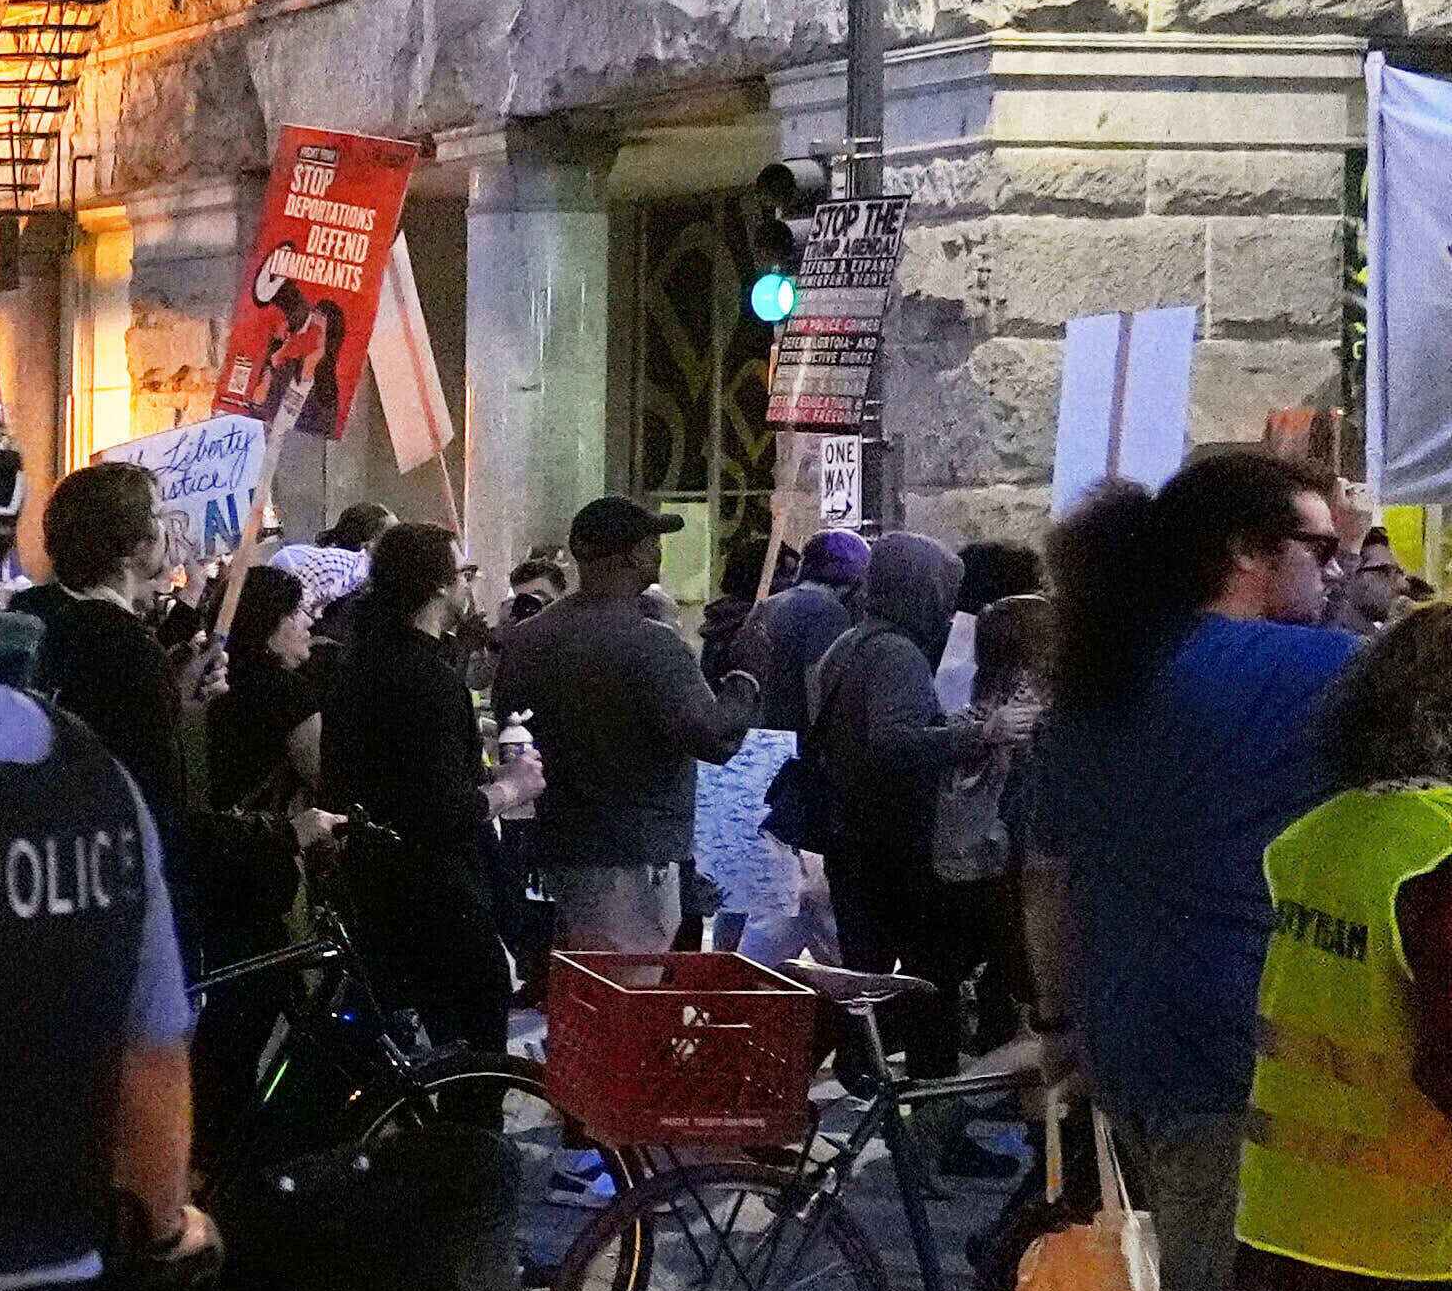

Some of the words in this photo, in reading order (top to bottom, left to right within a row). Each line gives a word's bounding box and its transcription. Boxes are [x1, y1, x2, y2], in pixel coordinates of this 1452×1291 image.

[290, 163, 336, 198] STOP
[283, 193, 377, 231] DEPORTATIONS
[811, 205, 860, 239] STOP
[864, 201, 905, 235] THE
[305, 224, 370, 264] DEFEND
[269, 247, 363, 293] IMMIGRANTS
[153, 423, 258, 490] Liberty
[825, 442, 856, 464] ONE
[825, 467, 856, 497] WAY
